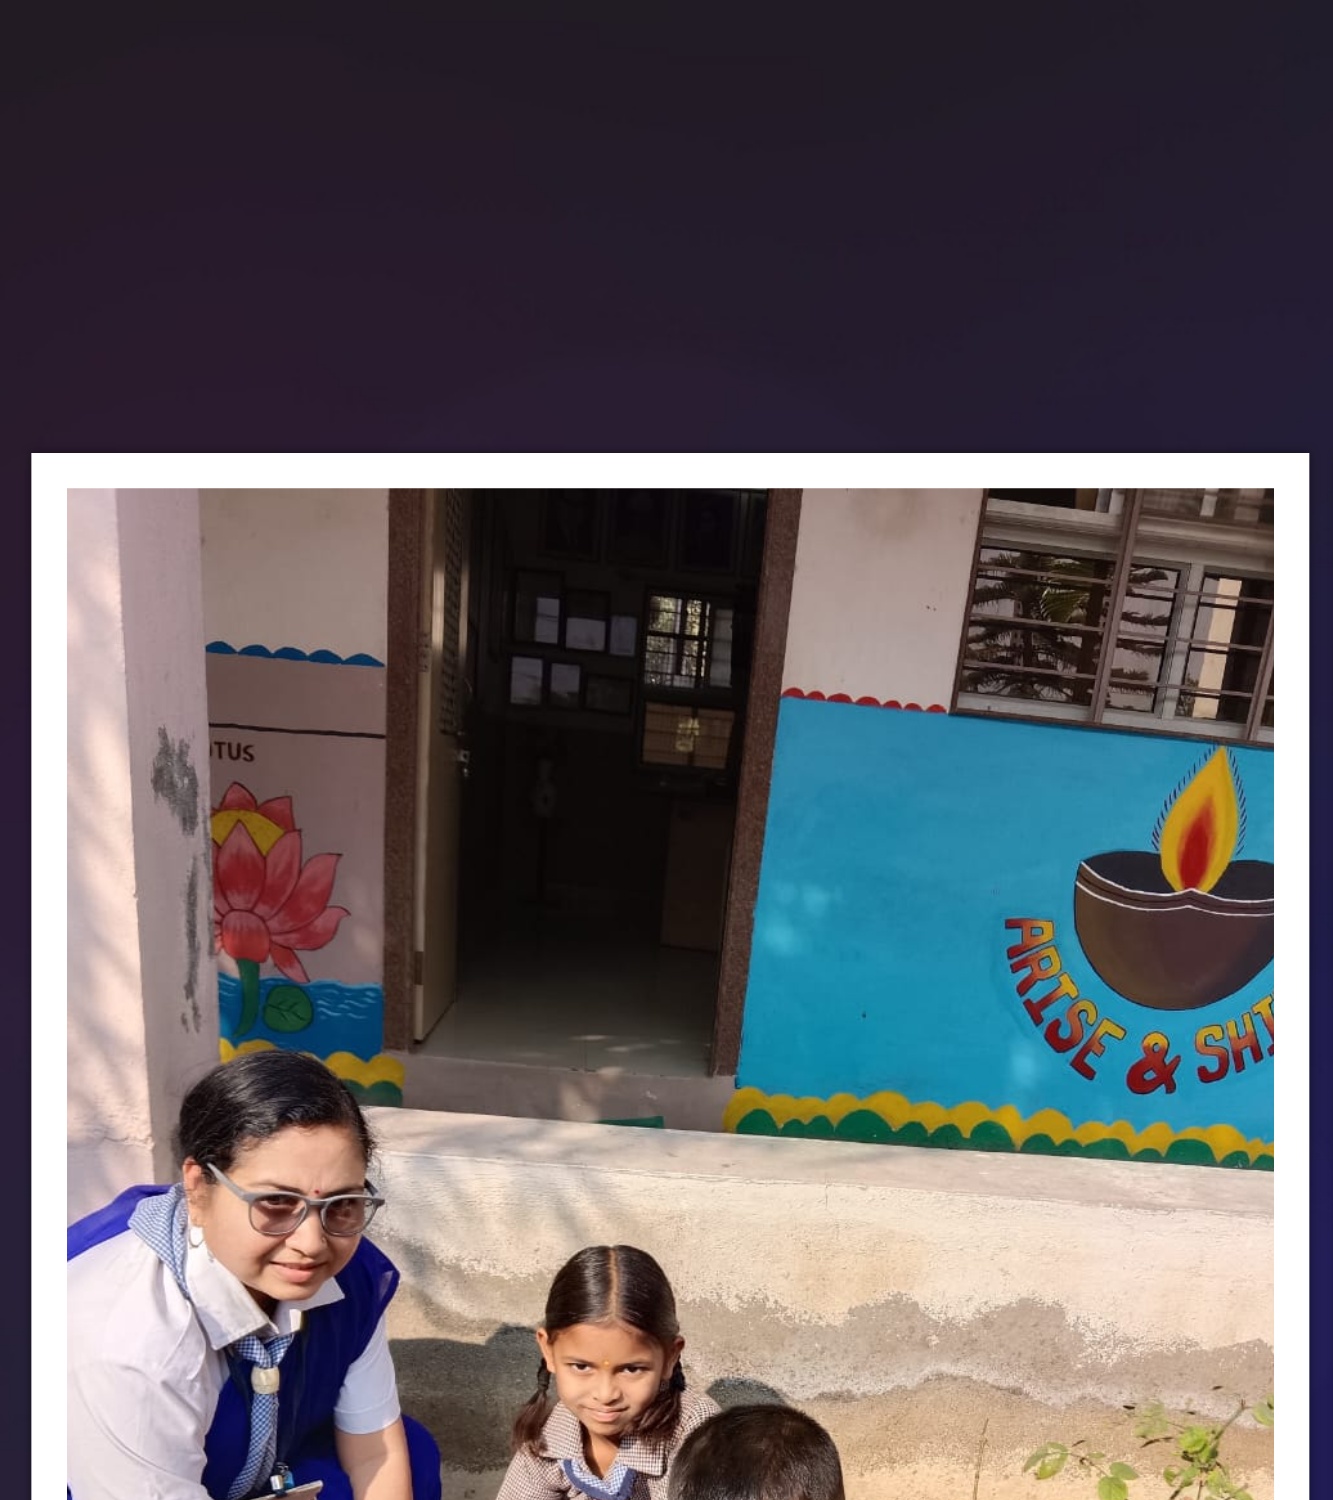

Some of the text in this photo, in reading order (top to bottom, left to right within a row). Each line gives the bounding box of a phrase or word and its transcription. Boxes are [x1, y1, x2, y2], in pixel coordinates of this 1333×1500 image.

[208, 741, 254, 762] TUS
[1005, 917, 1127, 1081] ARISE
[1126, 1031, 1182, 1094] &
